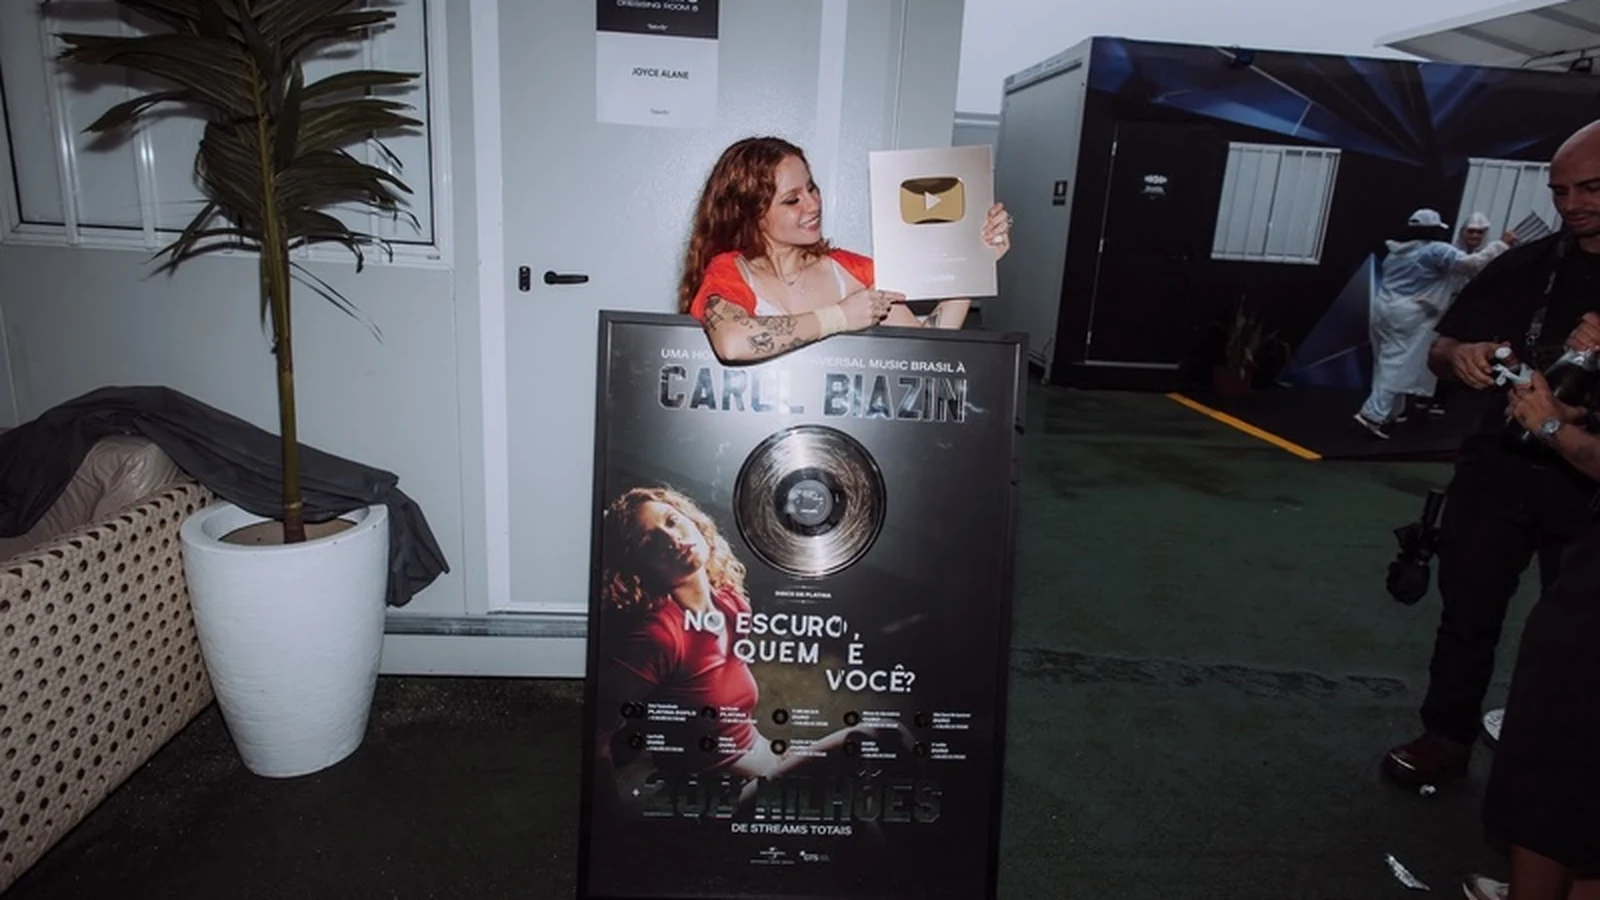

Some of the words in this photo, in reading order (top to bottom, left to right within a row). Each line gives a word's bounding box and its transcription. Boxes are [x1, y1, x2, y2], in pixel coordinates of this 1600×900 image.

[631, 67, 659, 77] JOYCE
[660, 69, 689, 80] ALANE
[660, 348, 690, 359] UMA
[868, 358, 909, 370] MUSIC
[910, 360, 955, 373] BRASIL
[823, 372, 967, 423] BIAZIN
[684, 610, 725, 632] NO
[733, 639, 819, 664] QUEM
[825, 663, 916, 692] VOCÊ?
[731, 823, 749, 834] DE
[750, 824, 809, 835] STREAMS
[810, 825, 853, 836] TOTAIS
